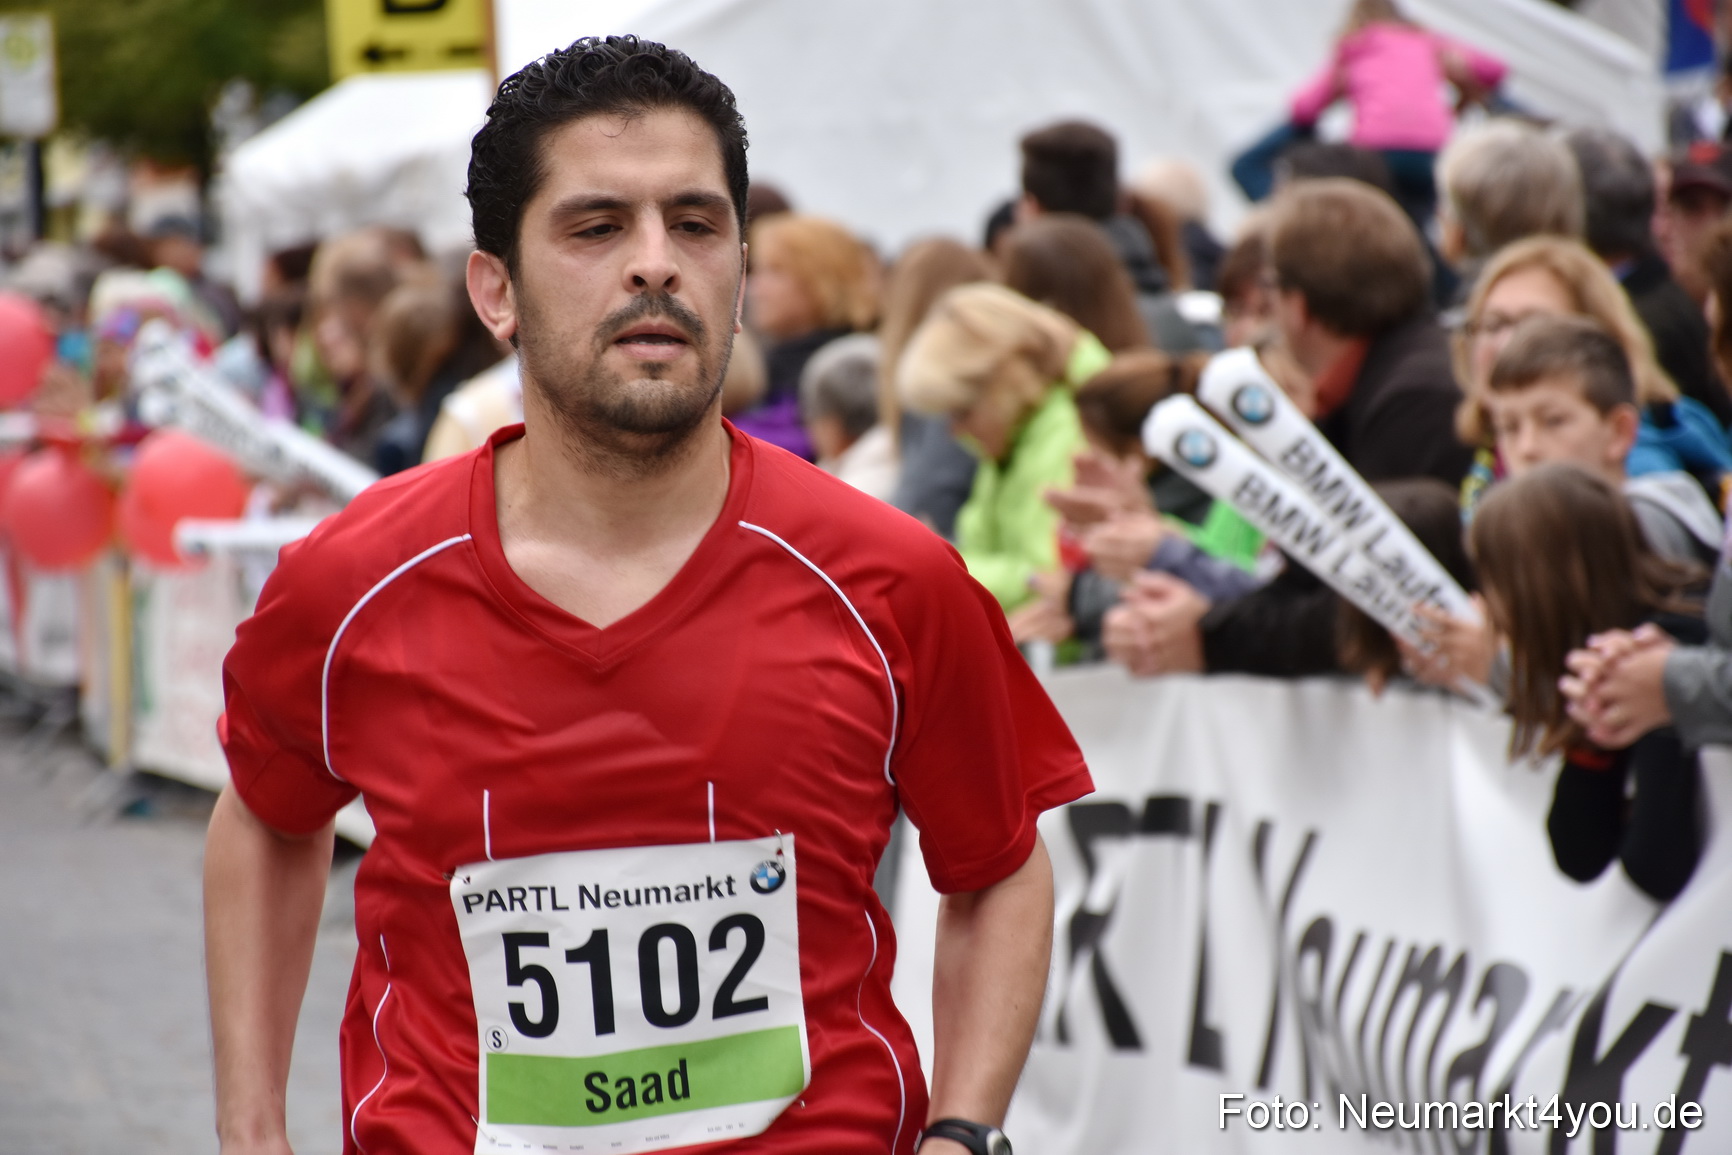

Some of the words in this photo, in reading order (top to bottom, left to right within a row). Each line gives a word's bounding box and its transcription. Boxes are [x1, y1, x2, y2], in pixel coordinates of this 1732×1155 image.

[1234, 473, 1335, 556] BMW
[1281, 436, 1374, 531] BMW
[462, 886, 570, 914] PARTL
[578, 875, 737, 911] Neumarkt
[502, 913, 769, 1038] 5102
[491, 1030, 503, 1049] S
[584, 1058, 691, 1113] Saad
